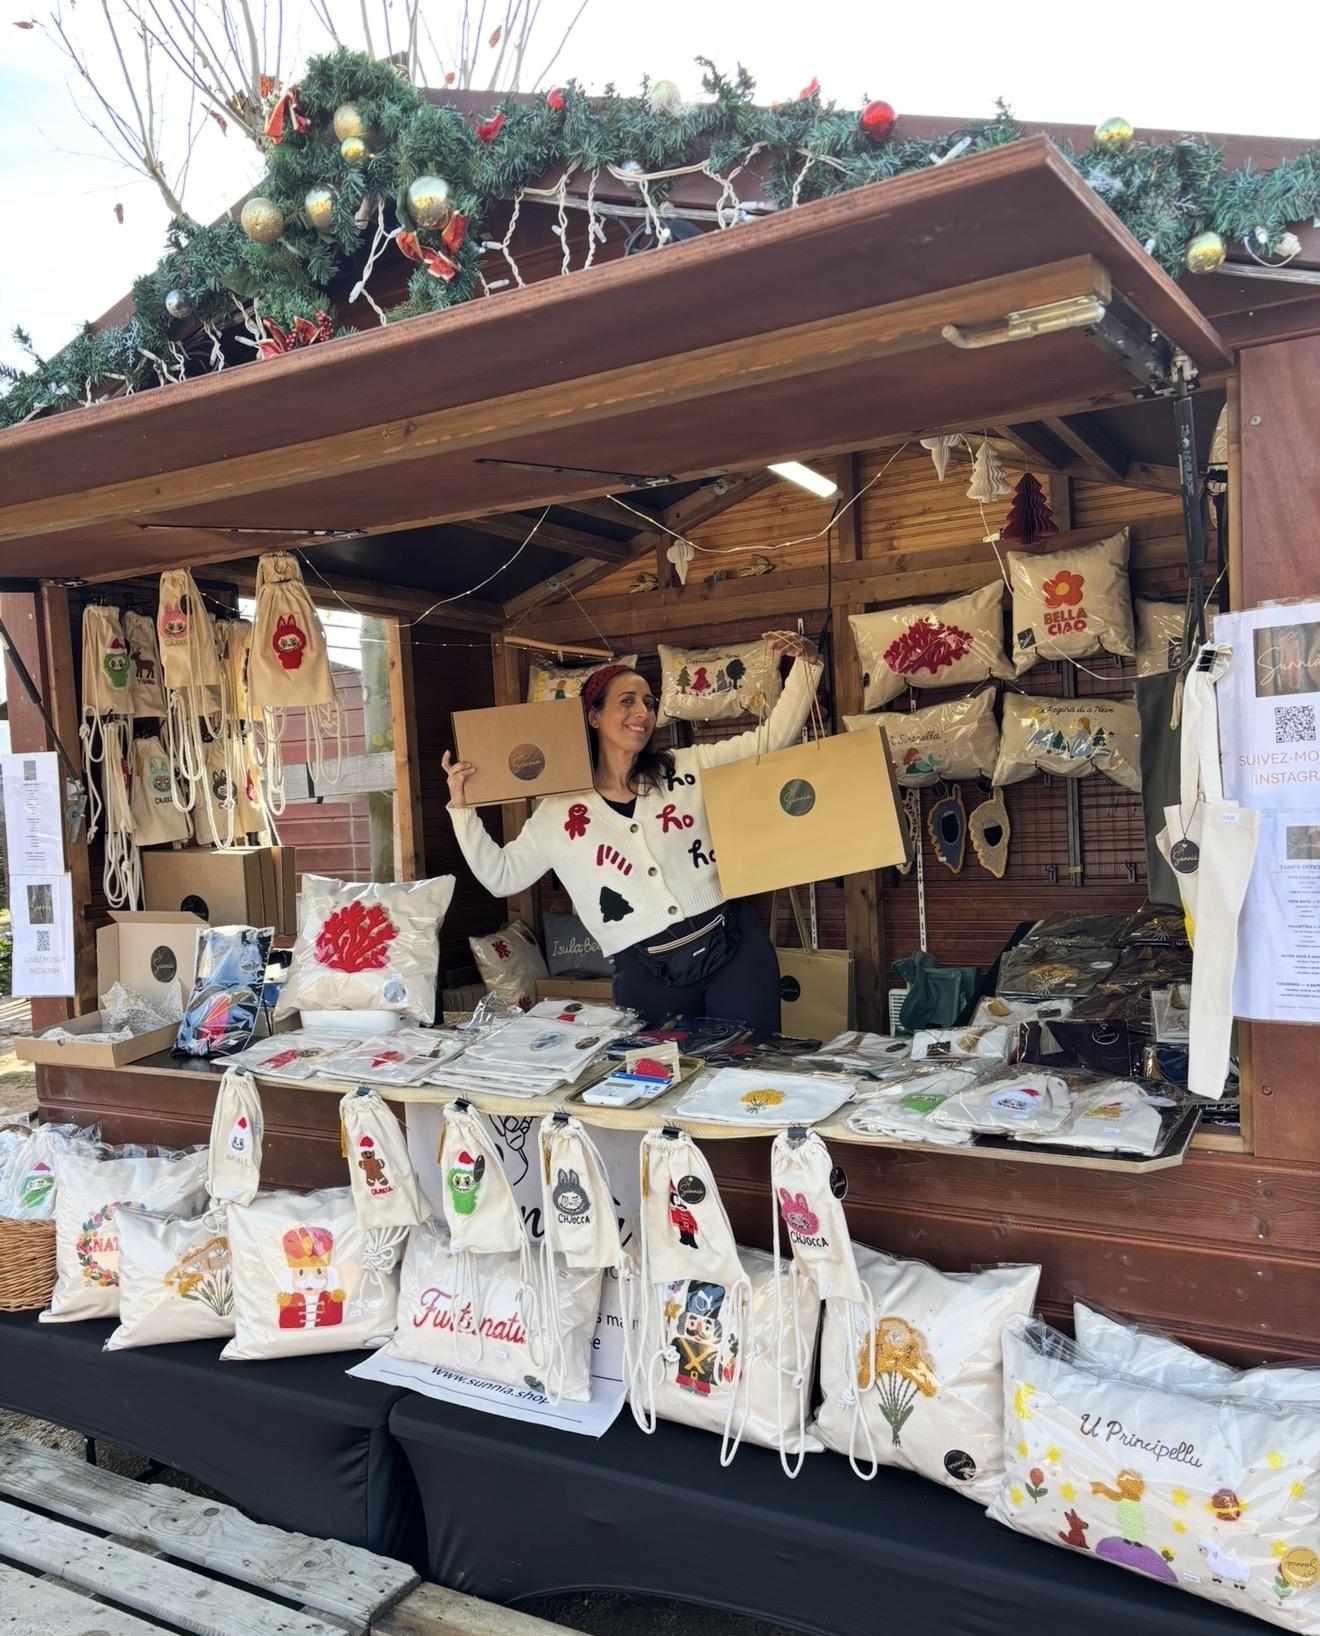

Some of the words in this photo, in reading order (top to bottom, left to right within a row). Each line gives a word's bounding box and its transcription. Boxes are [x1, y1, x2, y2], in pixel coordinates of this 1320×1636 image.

[1044, 608, 1088, 625] BELLA
[1047, 621, 1088, 636] CIAO
[1093, 705, 1115, 713] Neve
[663, 767, 696, 792] ho
[1255, 770, 1320, 785] INSTAGR
[656, 804, 694, 833] ho
[551, 936, 583, 957] Isula
[557, 1213, 592, 1226] CHJOCCA
[790, 1230, 830, 1247] CHJOCCA
[1080, 1413, 1102, 1438] U
[1106, 1420, 1203, 1468] Principellu
